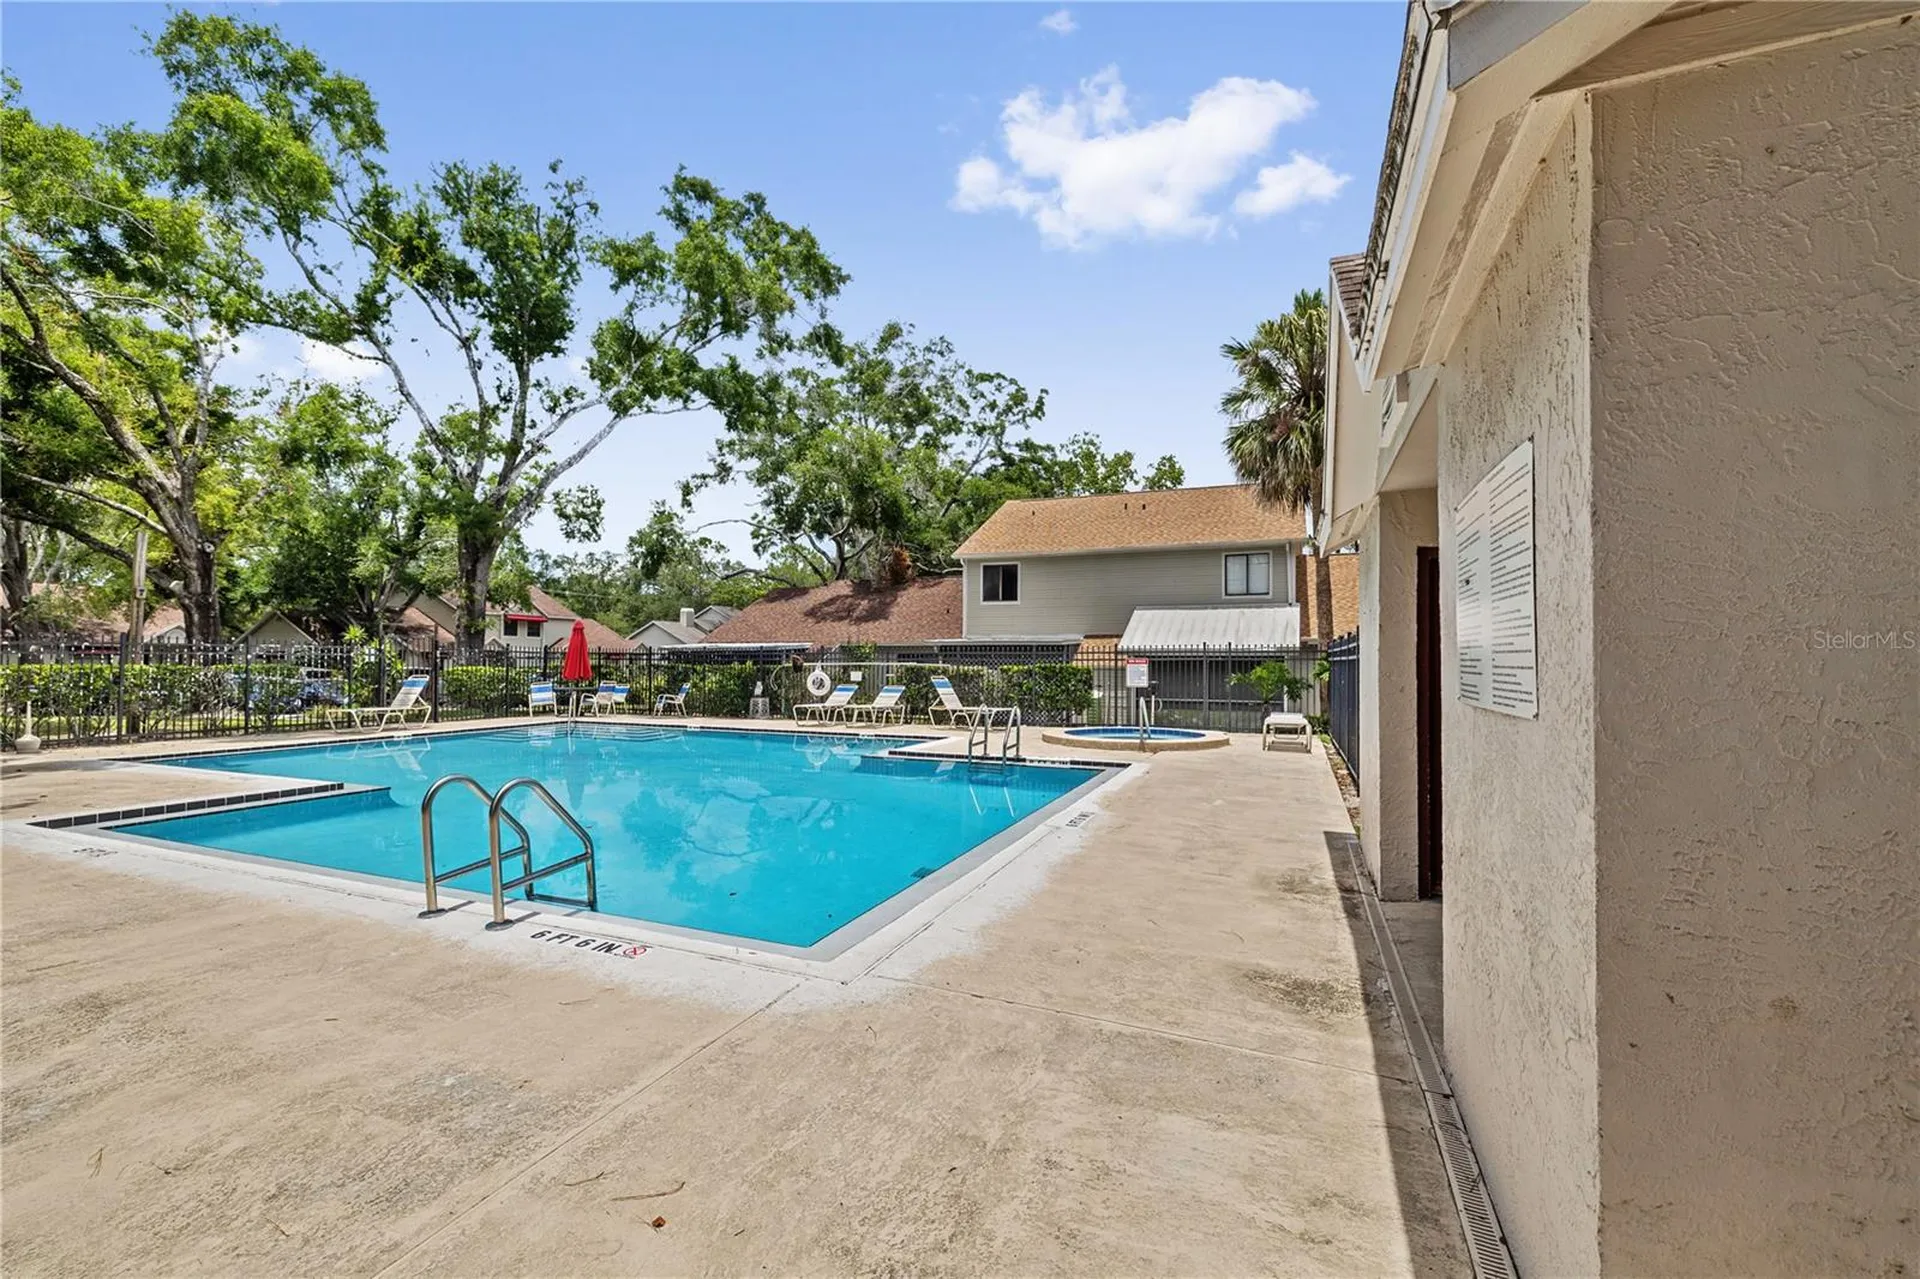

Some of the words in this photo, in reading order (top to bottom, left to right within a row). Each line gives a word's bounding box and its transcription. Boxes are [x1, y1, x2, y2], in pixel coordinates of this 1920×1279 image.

[530, 930, 552, 939] 6
[546, 933, 580, 944] FT
[574, 938, 596, 948] 6
